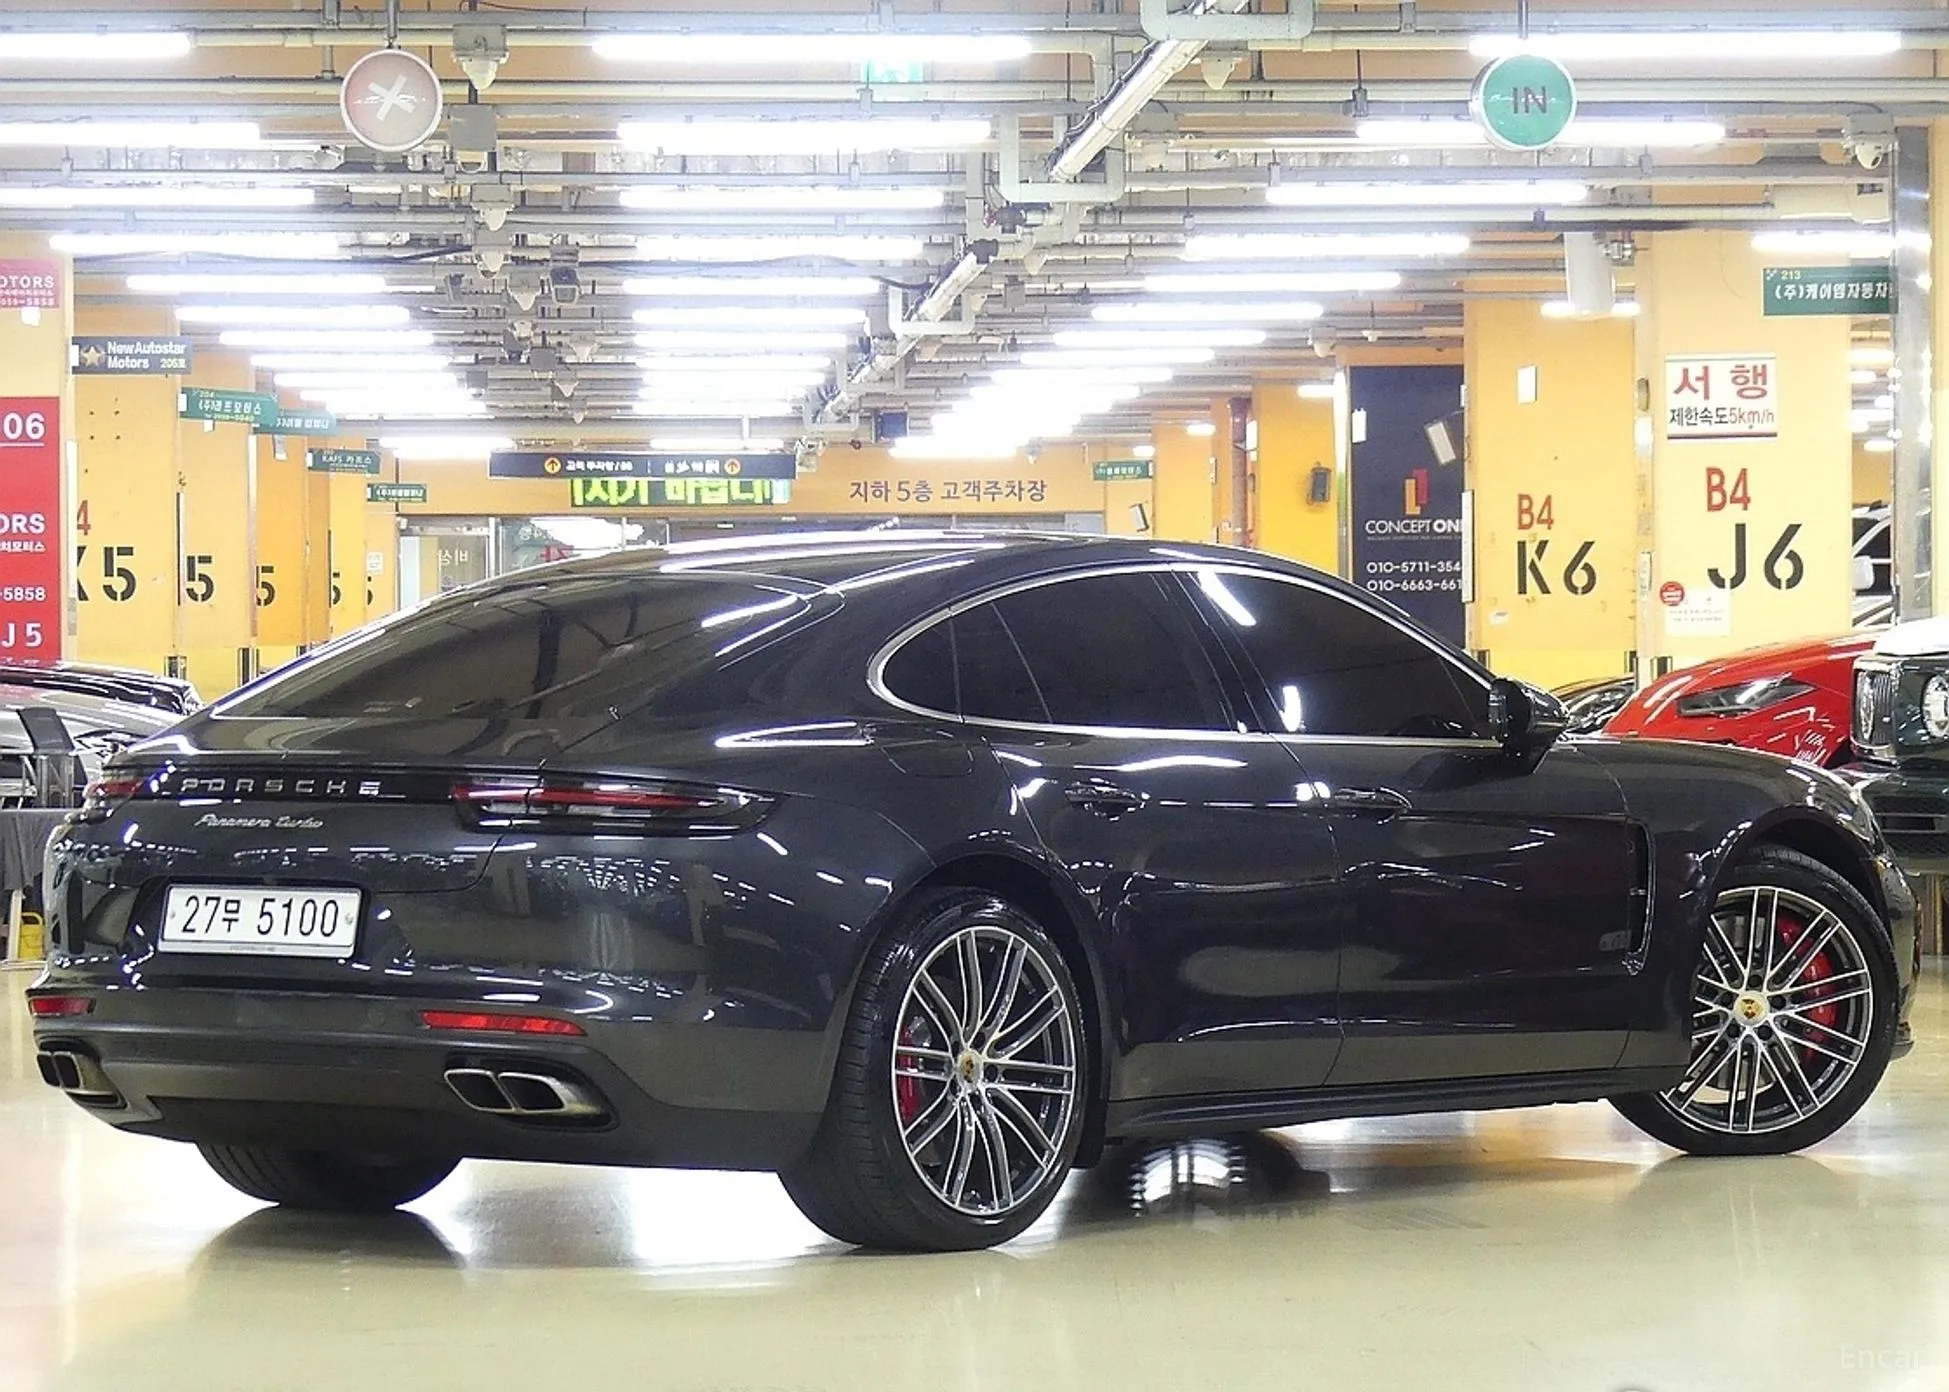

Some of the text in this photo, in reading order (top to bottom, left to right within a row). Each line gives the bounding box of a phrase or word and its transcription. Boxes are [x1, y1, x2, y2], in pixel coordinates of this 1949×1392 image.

[1512, 86, 1547, 114] IN
[0, 275, 54, 289] OTORS
[1781, 271, 1801, 280] 213
[107, 356, 150, 369] Motors
[3, 412, 46, 440] 06
[850, 480, 1048, 502] 지하 5층 고객주차장
[1706, 467, 1751, 512] B4
[1517, 494, 1554, 530] B4
[1365, 519, 1462, 534] CONCEPT ON
[180, 778, 381, 796] PORSCHE
[194, 813, 272, 828] Panamera
[257, 898, 339, 937] 5100
